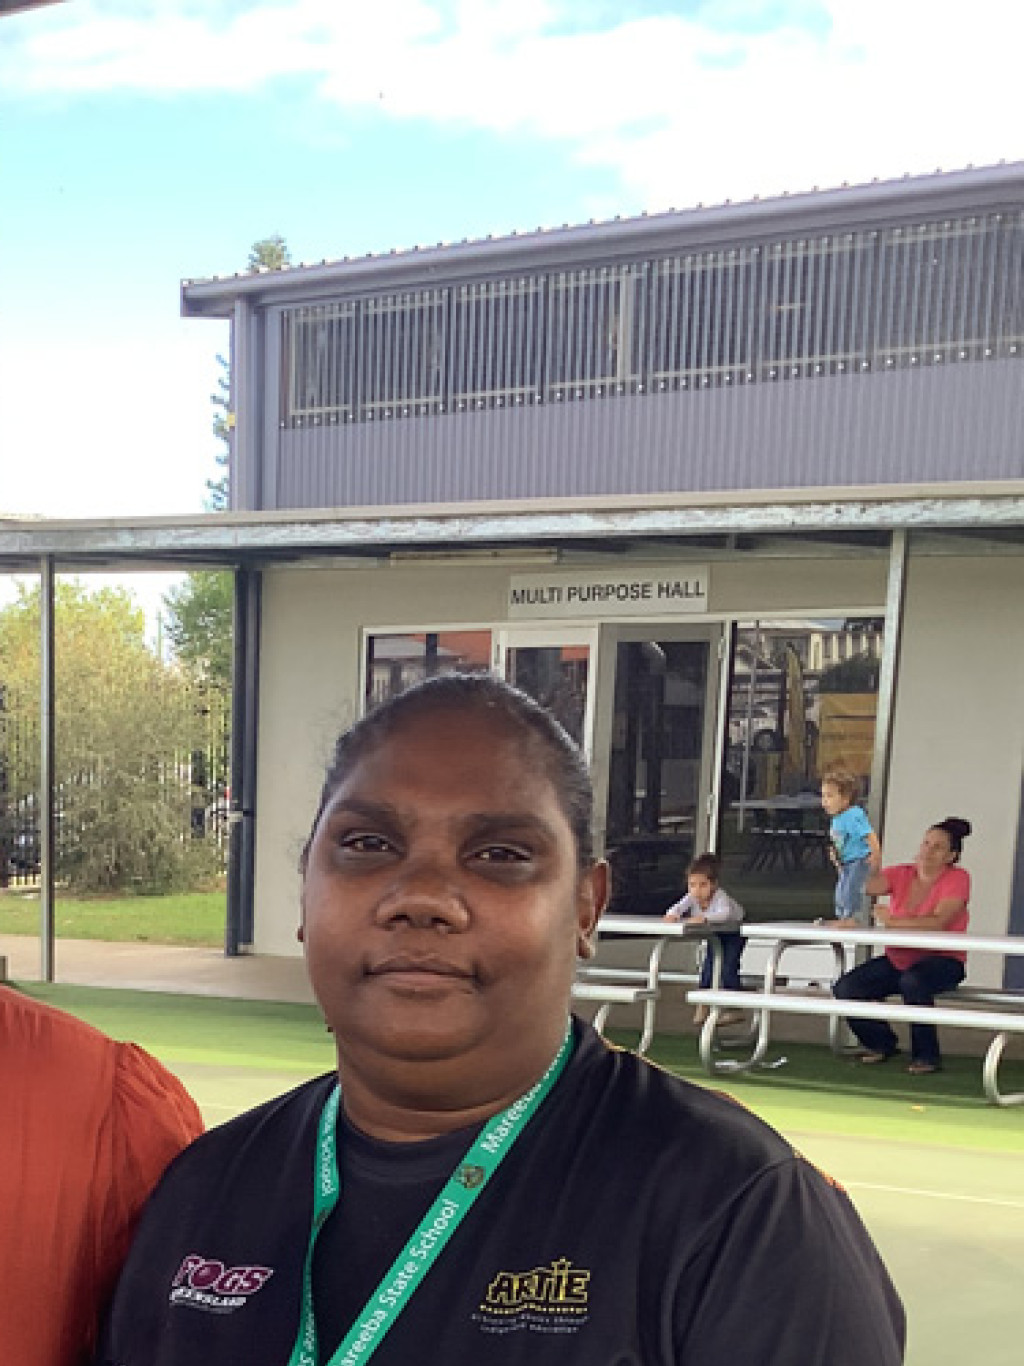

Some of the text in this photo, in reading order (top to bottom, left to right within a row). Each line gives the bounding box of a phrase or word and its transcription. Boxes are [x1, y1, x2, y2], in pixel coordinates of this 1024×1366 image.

[511, 581, 705, 604] MULTI PURPOSE HALL
[379, 1261, 419, 1308] State
[409, 1199, 460, 1260] School
[486, 1259, 590, 1304] ARTIE
